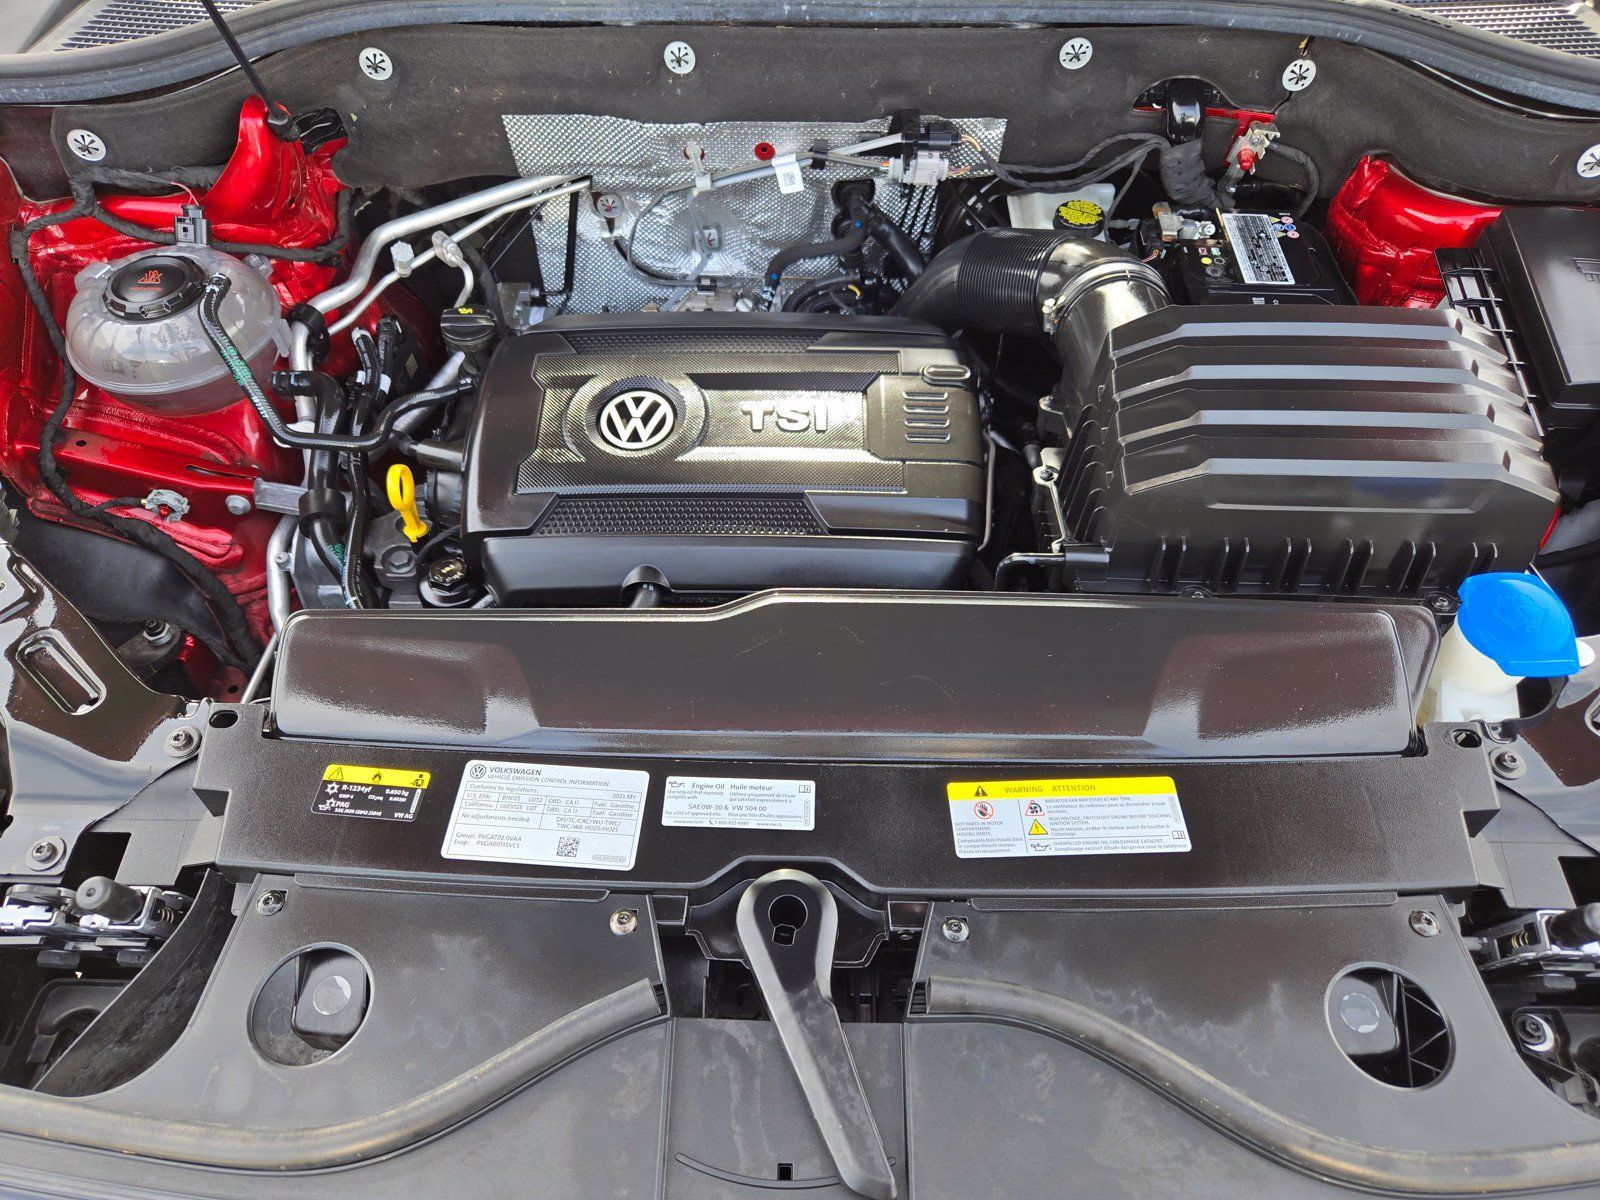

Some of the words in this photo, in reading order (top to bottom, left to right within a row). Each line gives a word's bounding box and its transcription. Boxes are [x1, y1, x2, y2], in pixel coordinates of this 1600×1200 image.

[741, 400, 828, 431] TSI
[490, 767, 542, 775] VOLKSWAGEN
[342, 785, 372, 793] R-1234yf
